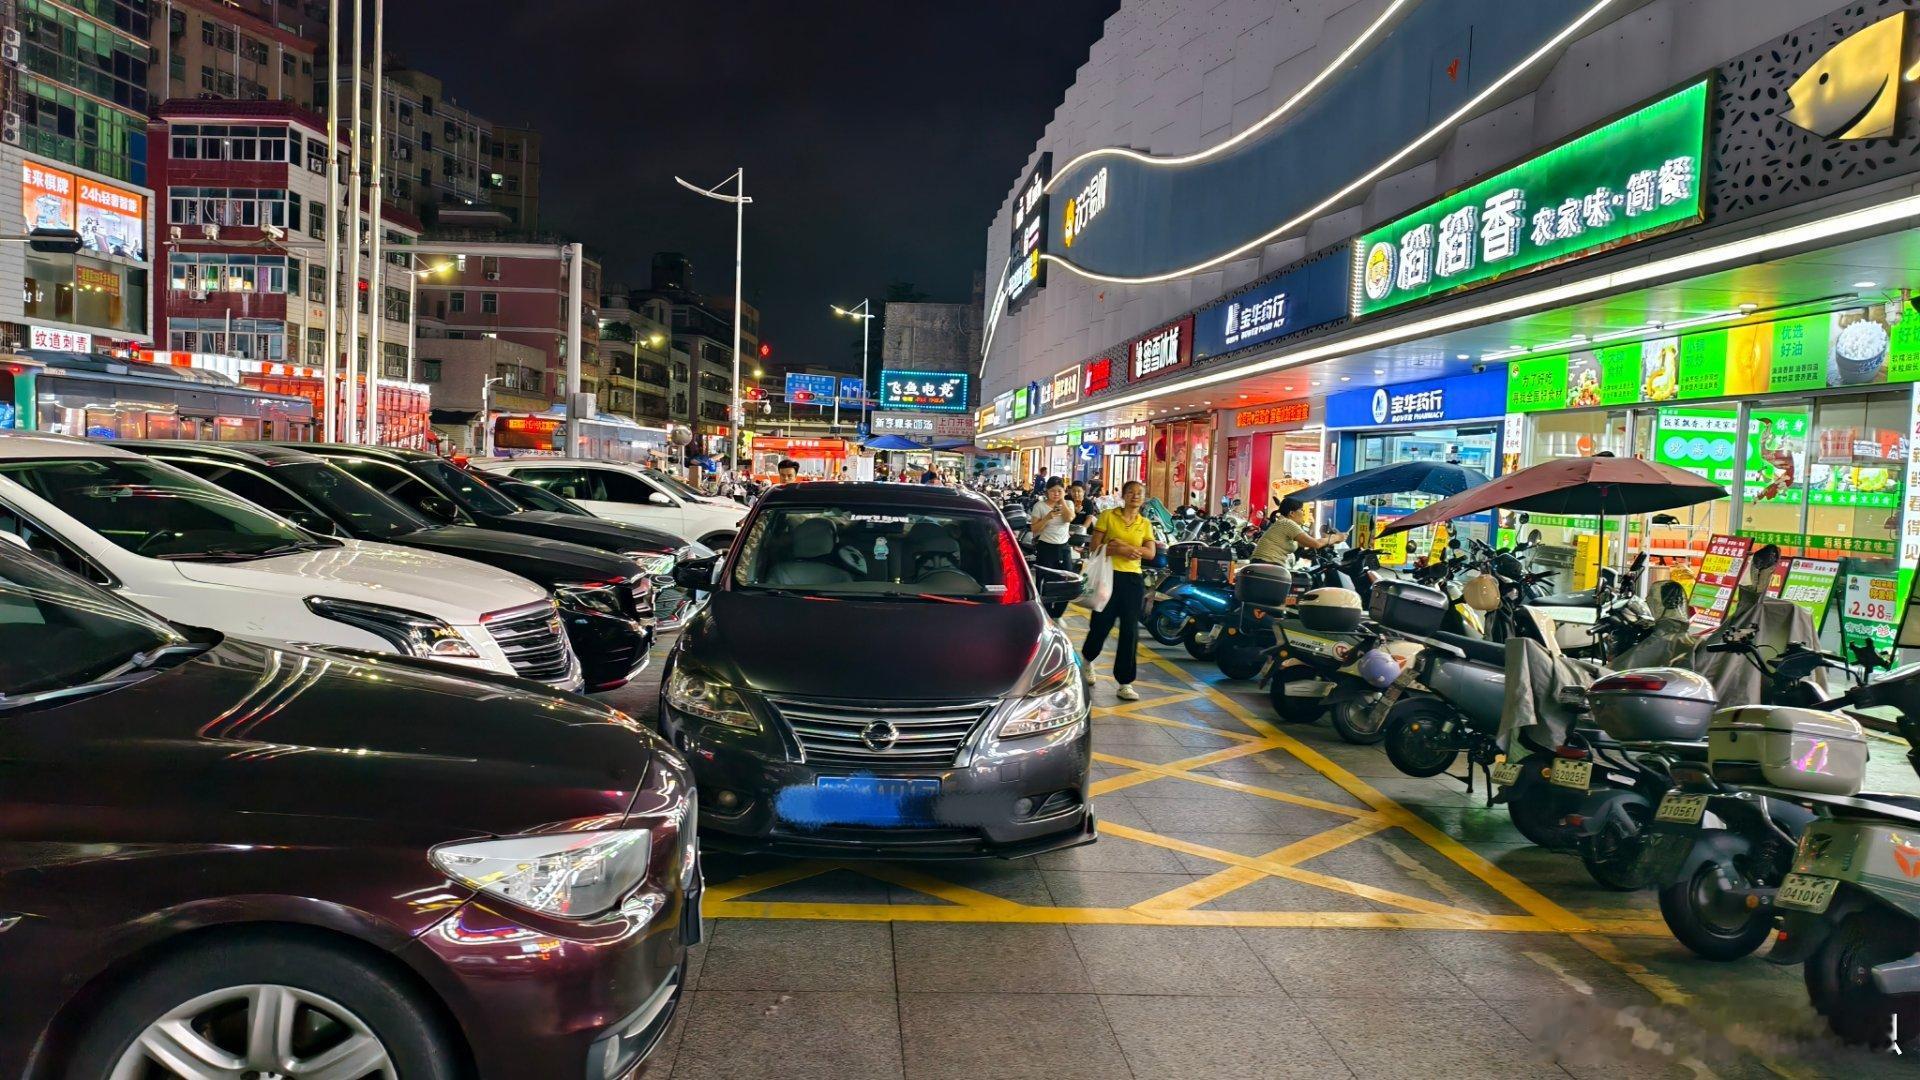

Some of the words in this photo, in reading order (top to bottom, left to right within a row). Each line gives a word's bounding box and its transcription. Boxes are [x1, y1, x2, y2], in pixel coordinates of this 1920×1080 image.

[1397, 189, 1526, 289] 稻稻香
[1240, 293, 1285, 330] 宝华药行
[35, 331, 87, 354] 纹道刺青
[1782, 325, 1804, 340] 优选
[1143, 326, 1179, 375] 蜜雪冰城
[1780, 342, 1803, 357] 好油
[887, 381, 954, 398] 飞鱼电竞
[1391, 389, 1442, 414] 宝华药行
